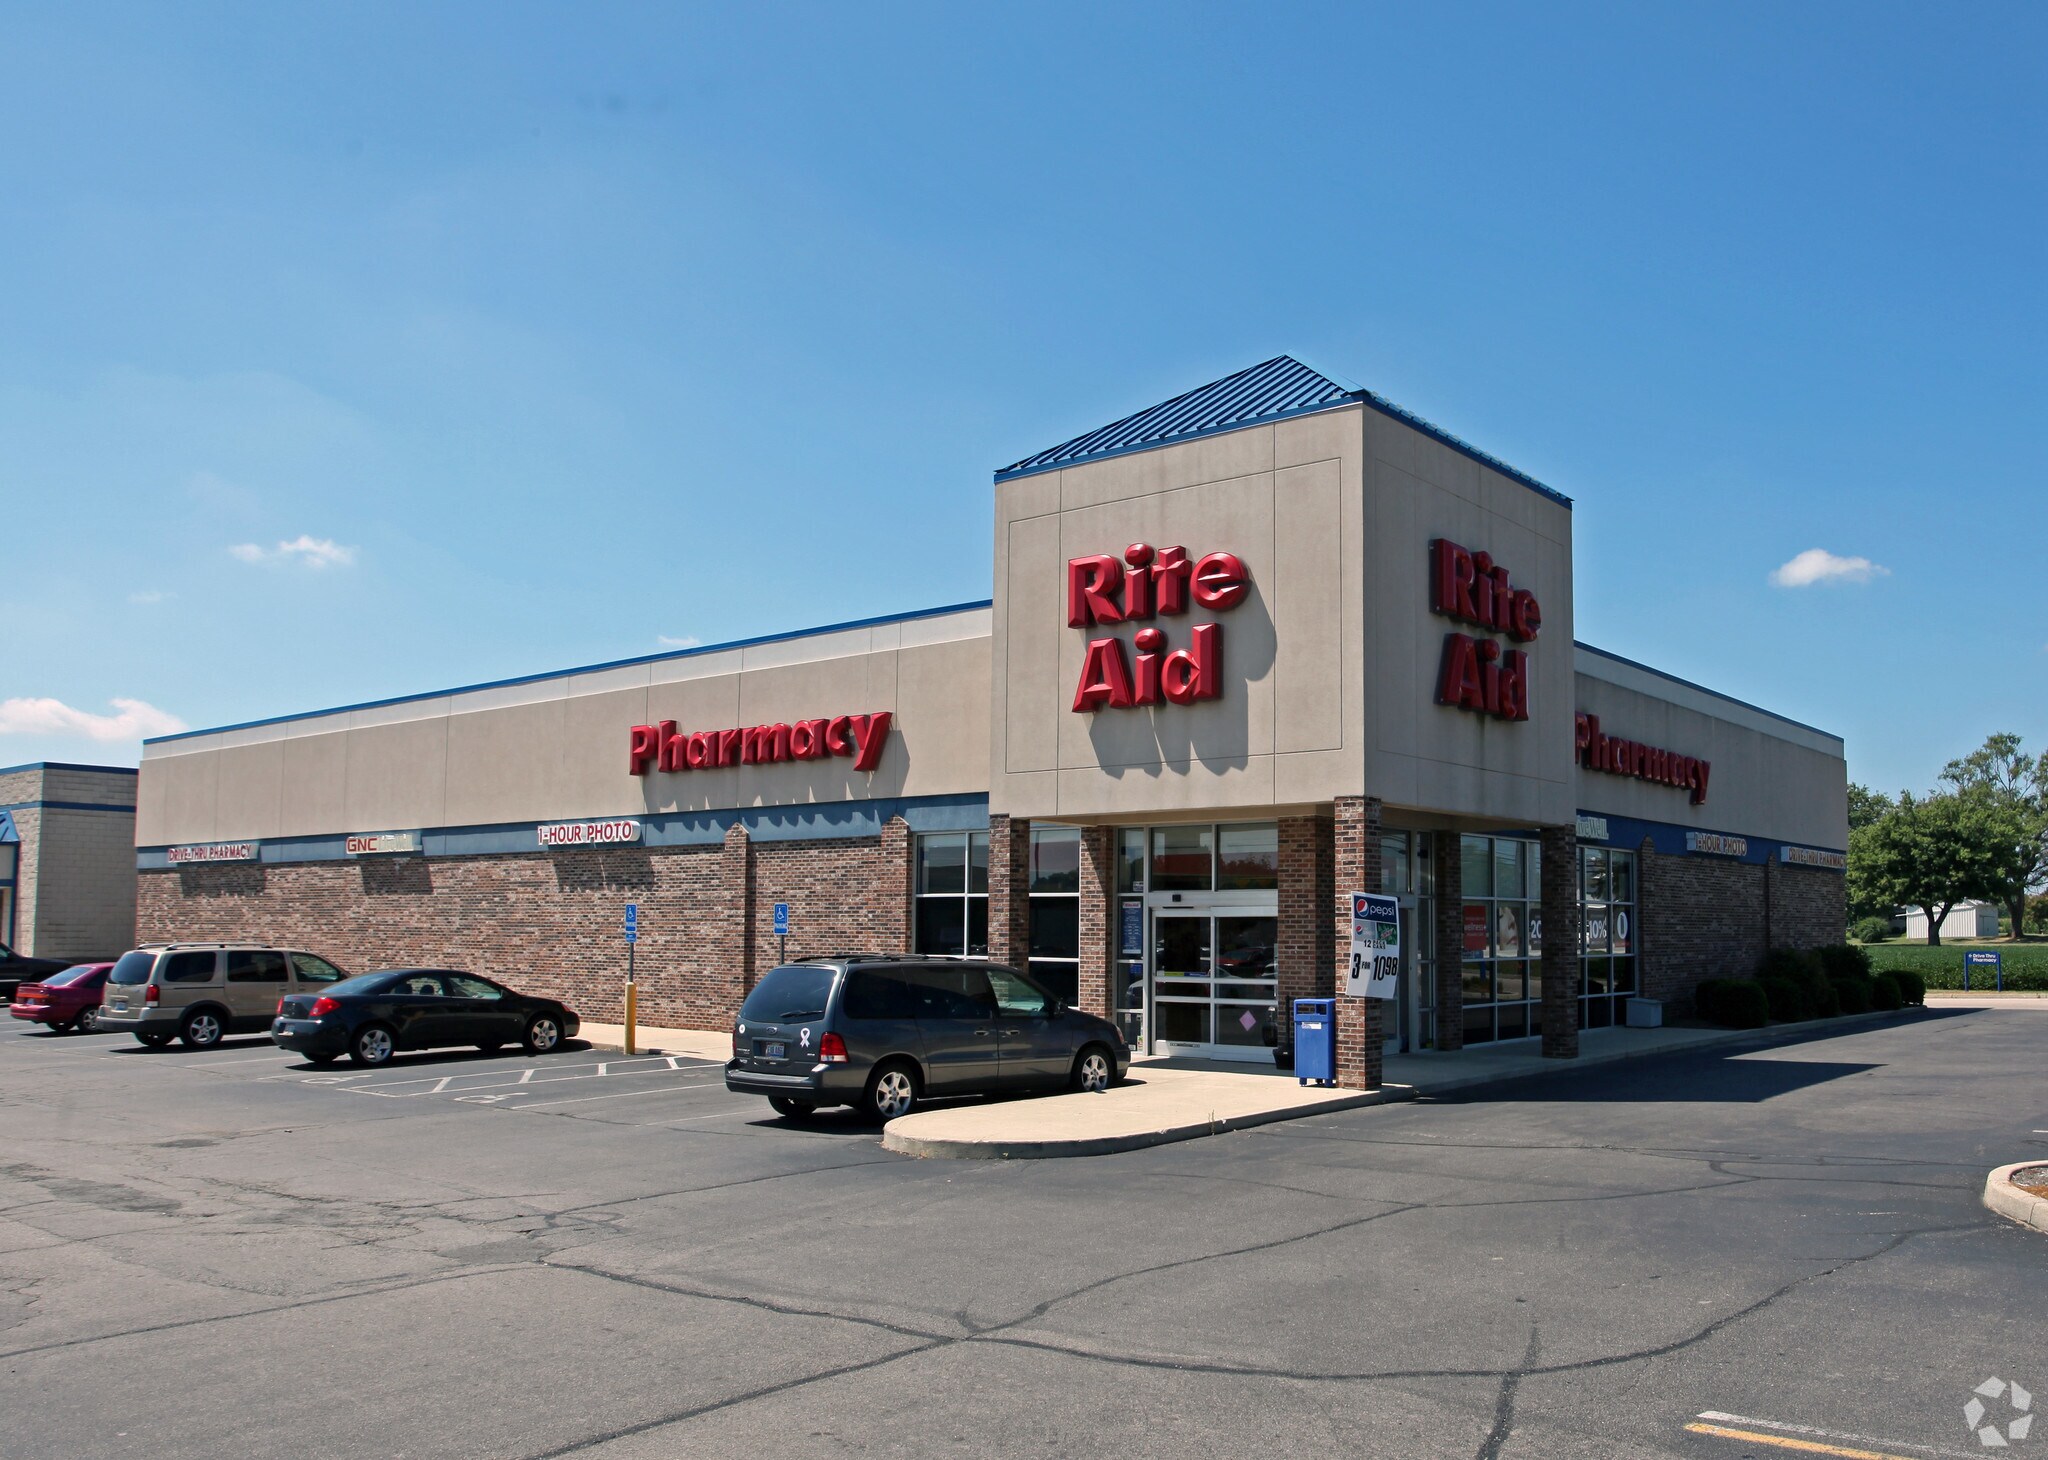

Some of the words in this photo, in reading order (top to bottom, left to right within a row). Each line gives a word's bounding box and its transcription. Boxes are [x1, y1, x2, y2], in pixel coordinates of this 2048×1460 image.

[1068, 543, 1250, 628] Rite
[1430, 538, 1541, 643] Rite
[1072, 623, 1223, 713] Aid
[1434, 632, 1530, 721] Aid
[630, 712, 893, 775] Pharmacy
[1575, 712, 1711, 804] Pharmacy
[346, 837, 378, 853] GNC
[538, 824, 584, 845] 1-HOUR
[586, 820, 634, 843] PHOTO
[168, 847, 208, 862] DRIVE-THRU
[209, 843, 252, 860] PHARMACY
[1722, 837, 1747, 857] PHOTO
[1370, 904, 1394, 916] pepsi
[1363, 939, 1372, 948] 12
[1352, 953, 1361, 979] 3
[1361, 961, 1371, 970] FOR
